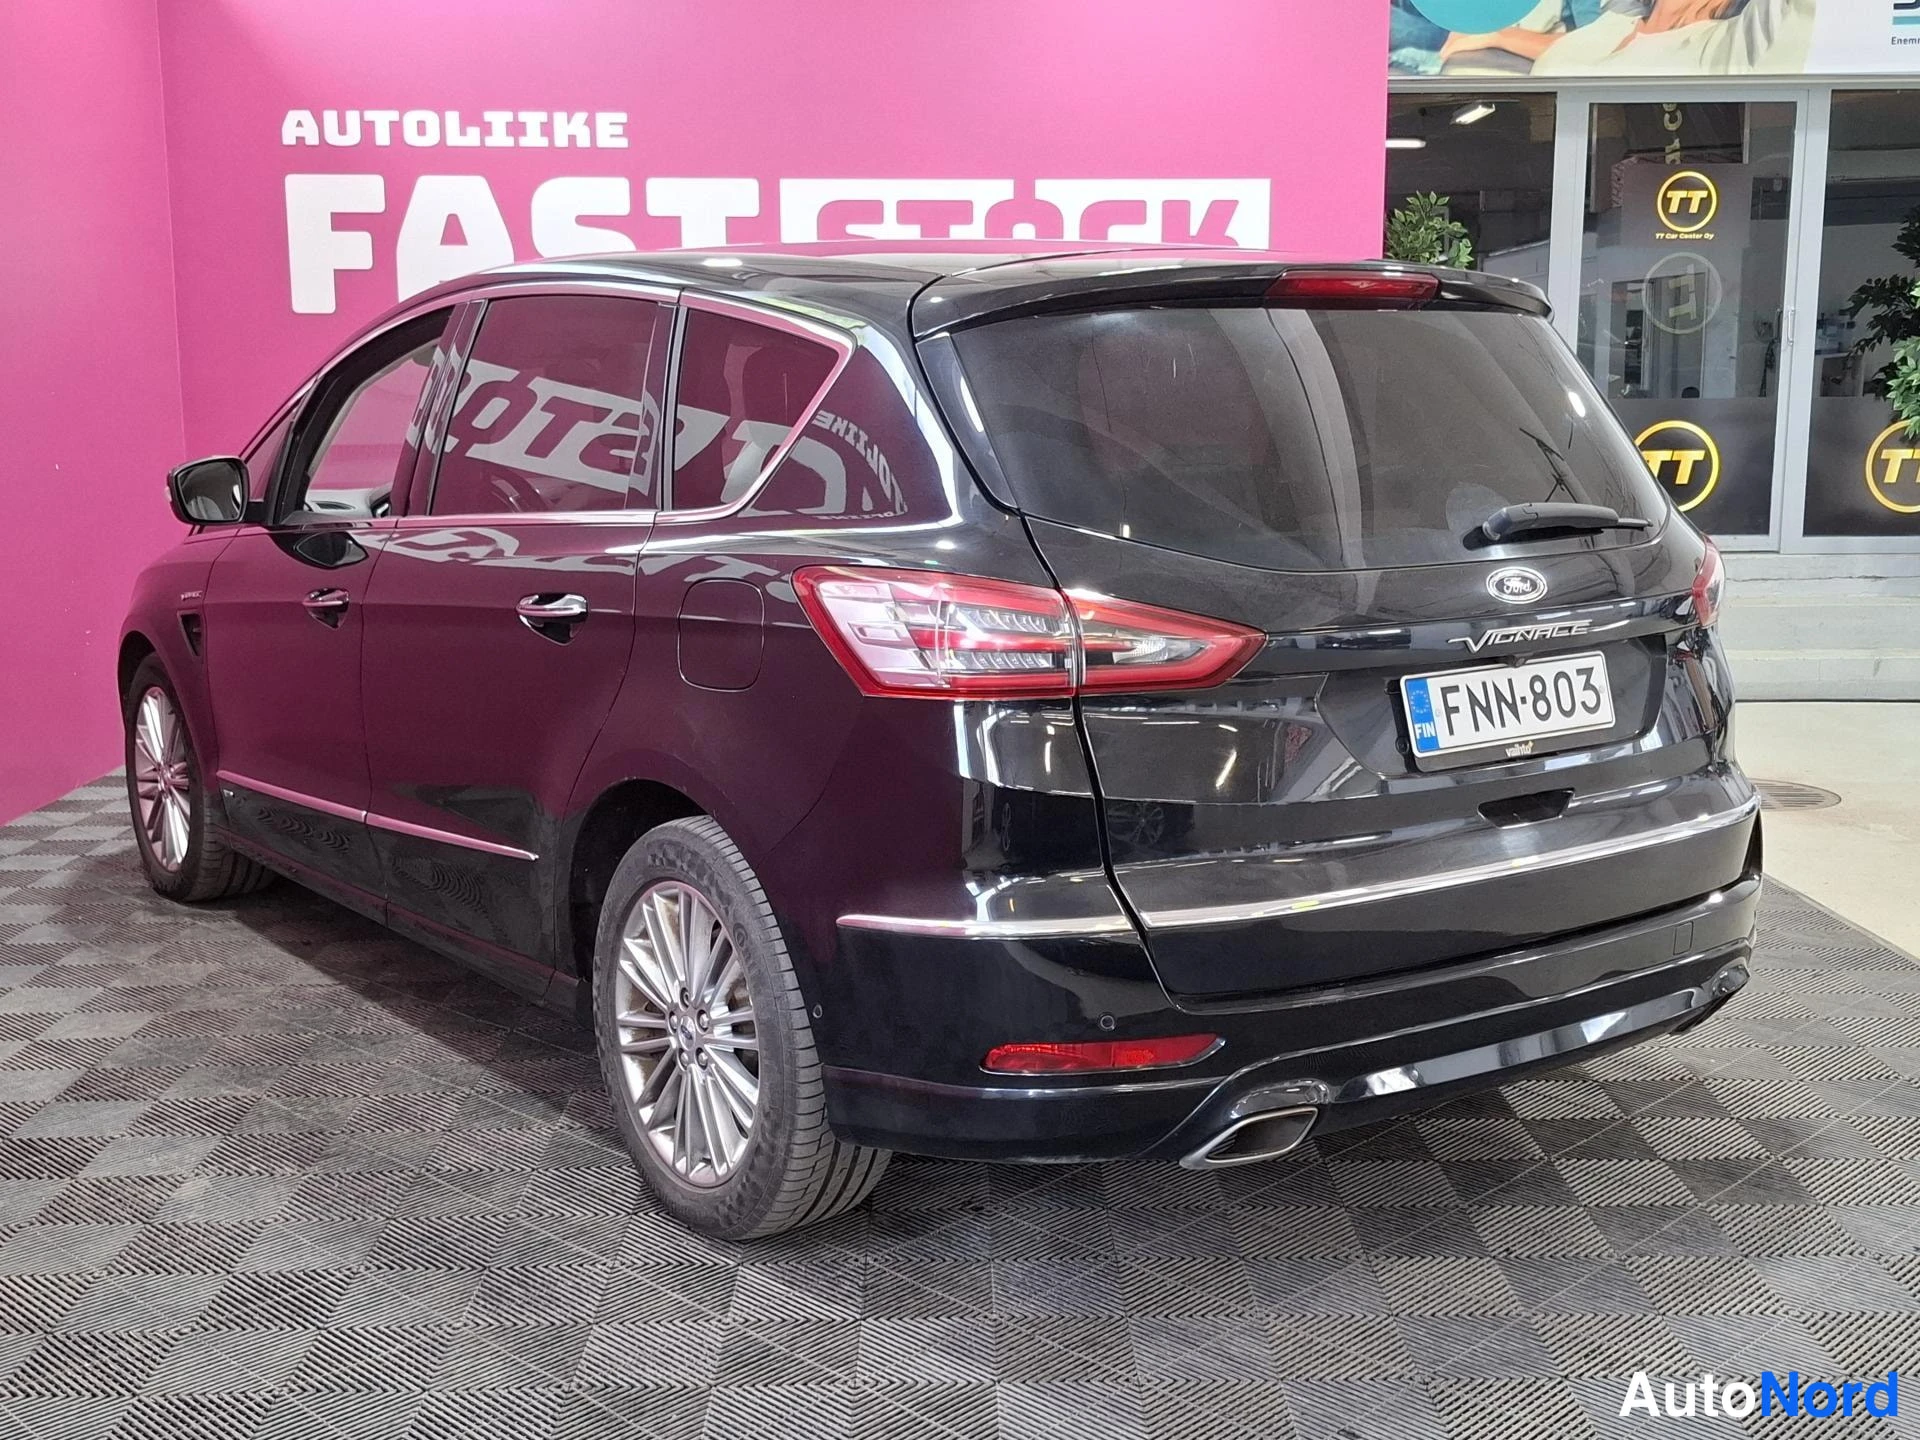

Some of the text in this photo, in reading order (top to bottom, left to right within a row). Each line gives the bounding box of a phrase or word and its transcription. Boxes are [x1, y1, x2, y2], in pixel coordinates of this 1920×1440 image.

[281, 109, 629, 148] AUTOLIIKE
[1667, 190, 1708, 214] TT
[284, 173, 758, 314] FAST
[1641, 450, 1705, 485] TT
[1881, 448, 1920, 483] T
[1503, 577, 1532, 594] Ford
[1447, 619, 1593, 654] VIGNALE
[1439, 666, 1601, 737] FNN-803
[1414, 722, 1436, 741] FIN
